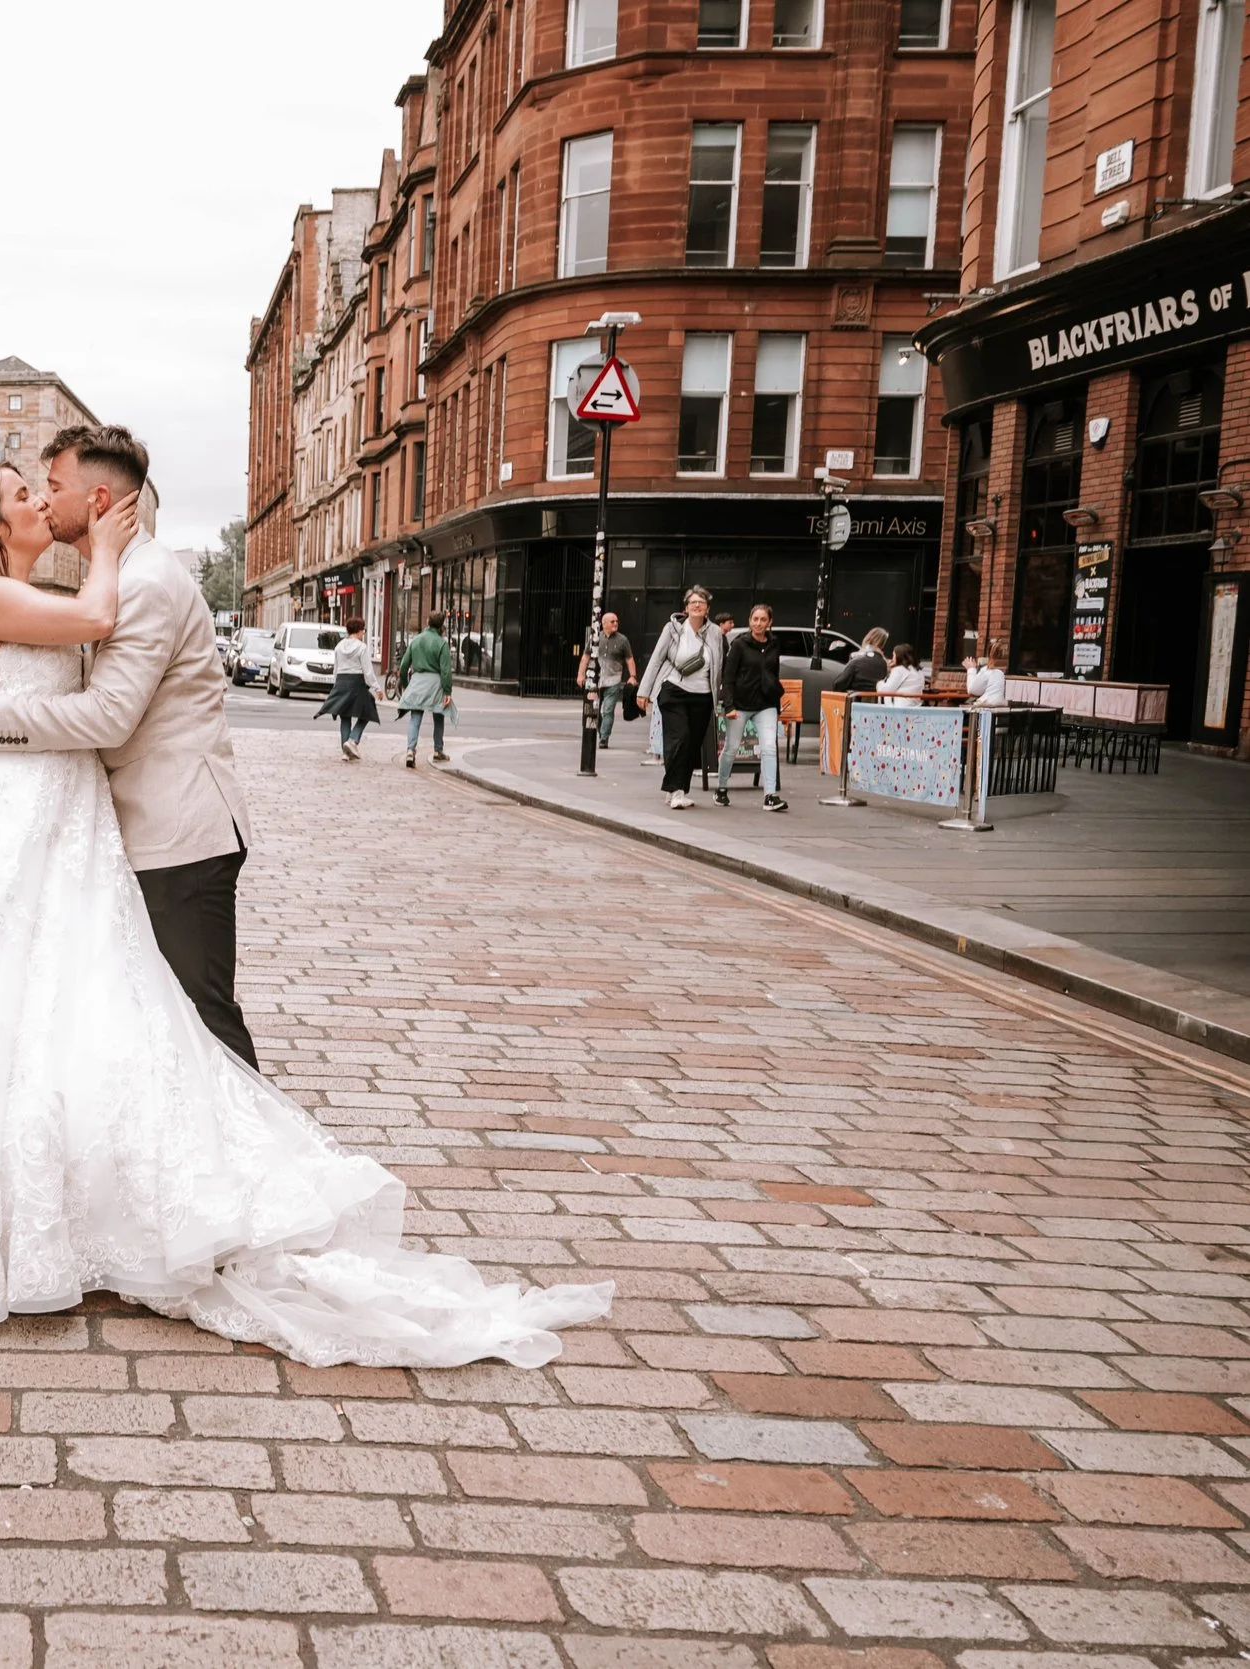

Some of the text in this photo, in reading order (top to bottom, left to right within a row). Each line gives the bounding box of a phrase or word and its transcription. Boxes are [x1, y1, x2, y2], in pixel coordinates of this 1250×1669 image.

[1101, 161, 1126, 182] STREET
[1027, 289, 1200, 371] BLACKFRIARS
[1209, 283, 1233, 312] OF
[806, 516, 927, 536] Tsami Axis
